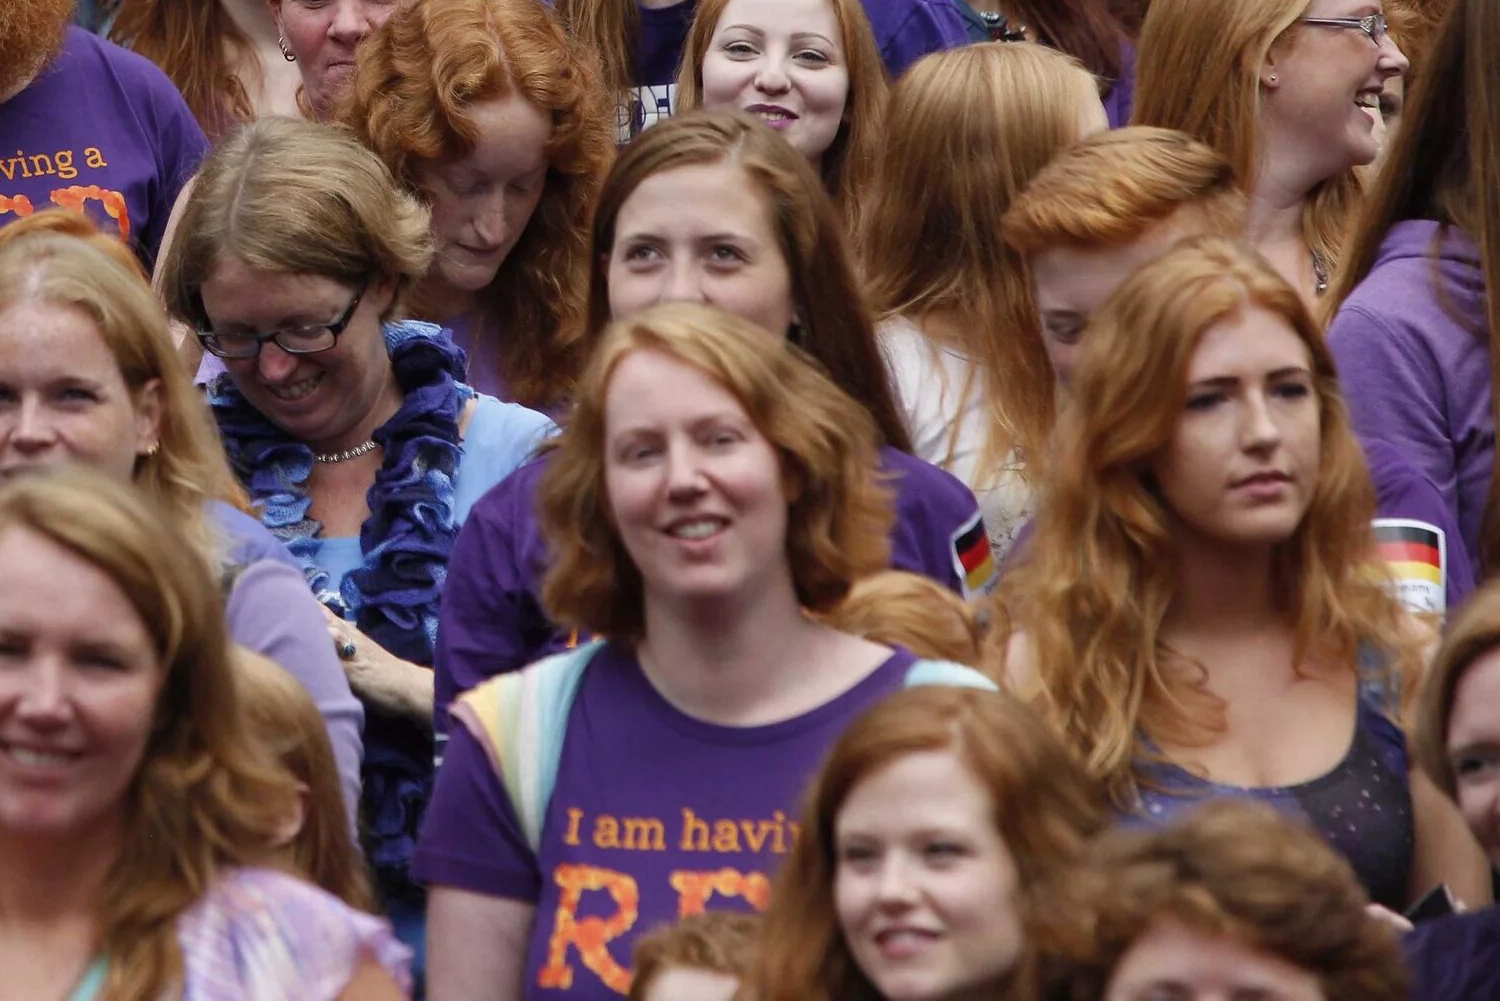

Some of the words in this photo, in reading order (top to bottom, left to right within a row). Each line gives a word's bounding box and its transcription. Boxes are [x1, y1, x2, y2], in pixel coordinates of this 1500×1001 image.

[84, 147, 108, 169] a
[564, 807, 584, 846] I
[593, 815, 666, 851] am
